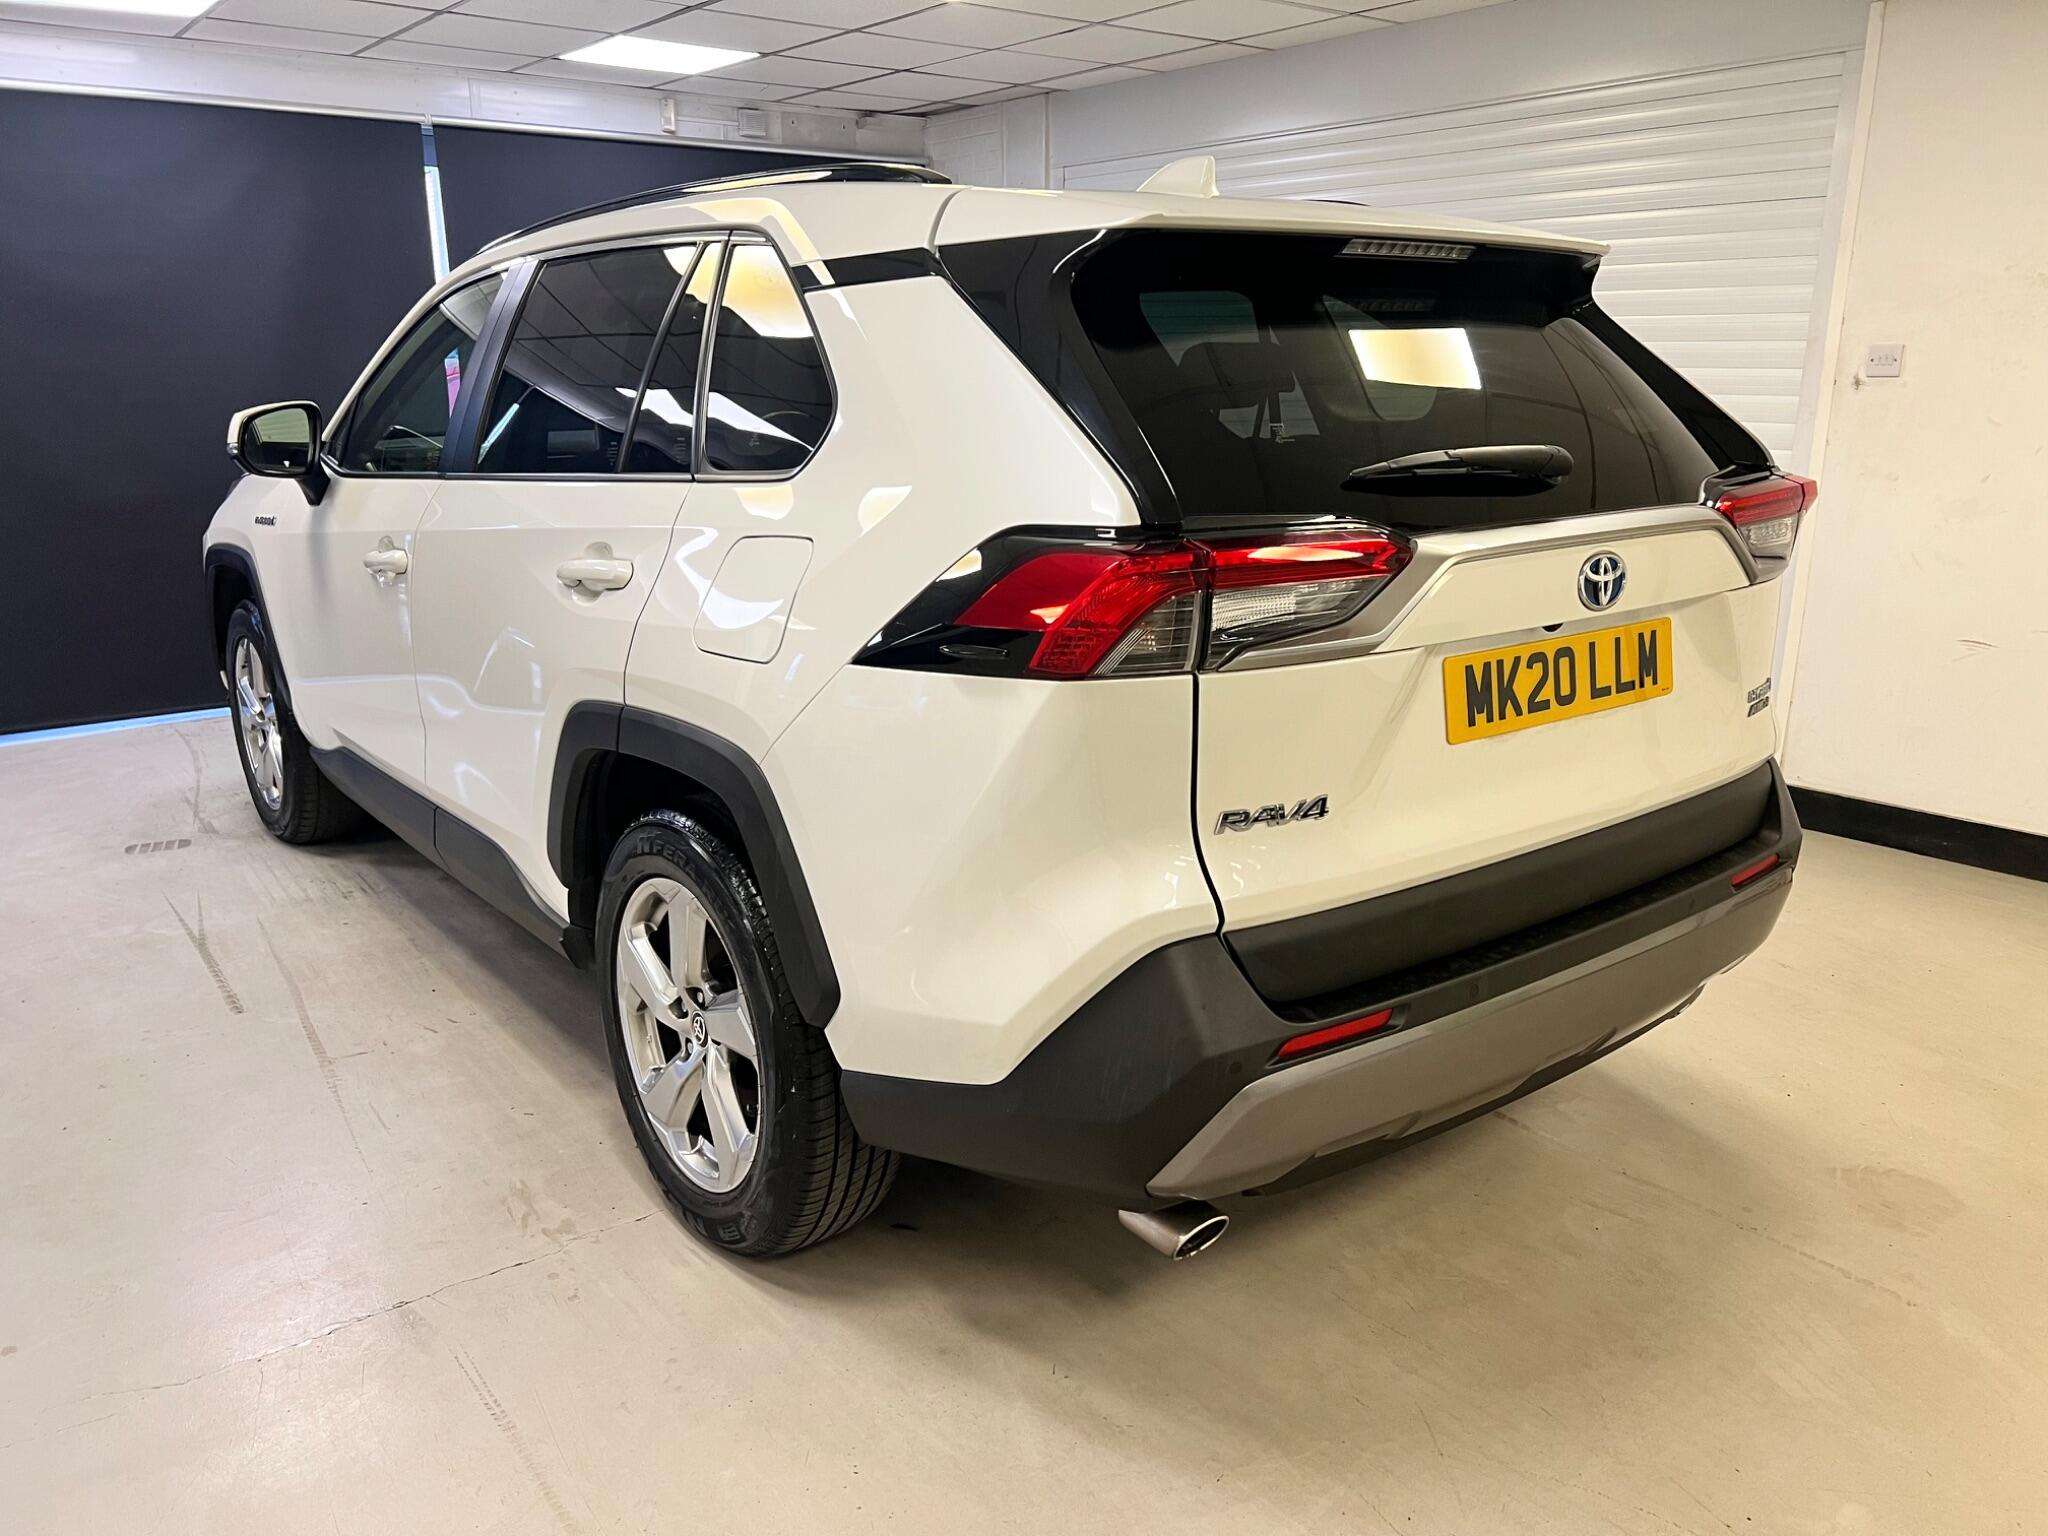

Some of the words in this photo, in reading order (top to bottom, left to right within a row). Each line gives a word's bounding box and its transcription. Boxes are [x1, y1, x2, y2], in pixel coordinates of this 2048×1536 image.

[1465, 646, 1577, 728] MK20
[1588, 629, 1658, 700] LLM
[1213, 793, 1330, 836] RAV4
